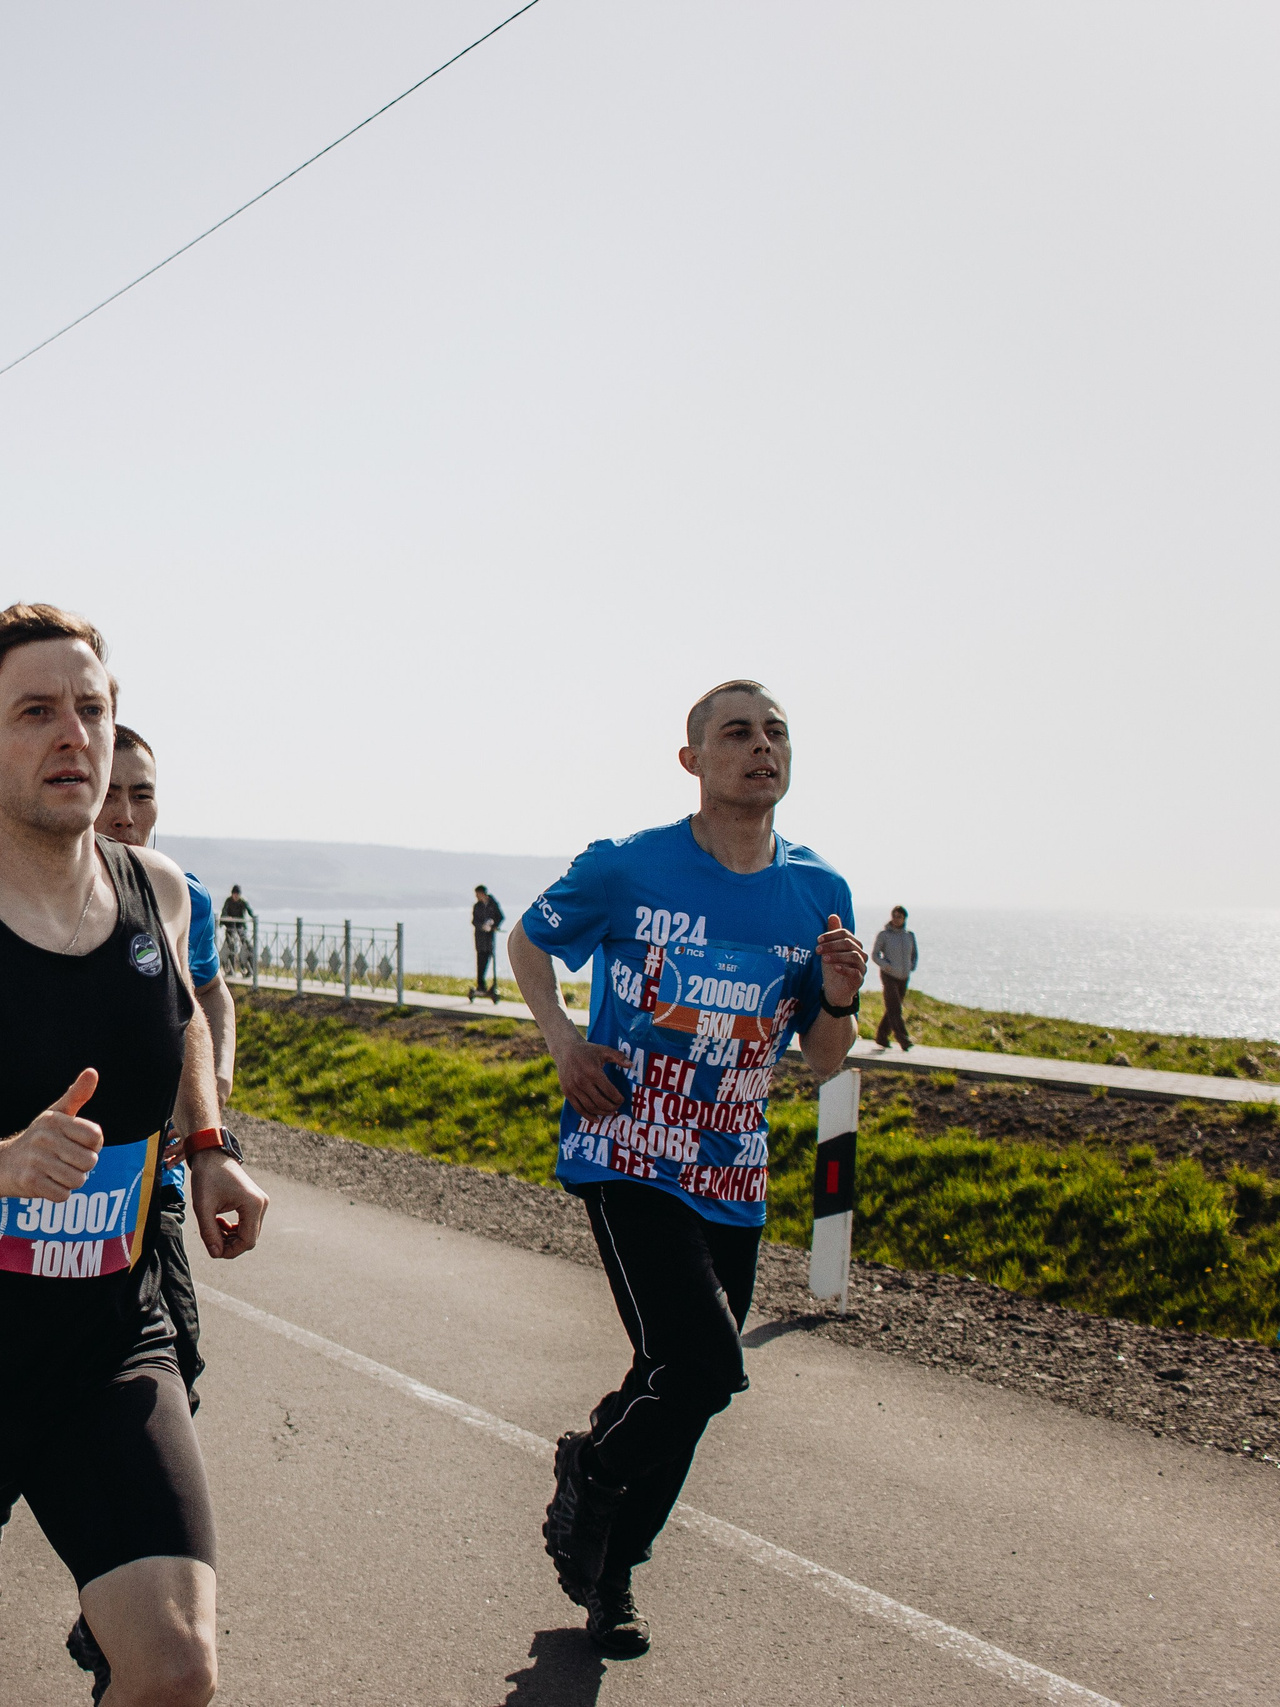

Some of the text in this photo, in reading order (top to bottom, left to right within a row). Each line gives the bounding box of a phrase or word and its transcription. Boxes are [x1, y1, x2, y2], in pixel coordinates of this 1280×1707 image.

[536, 894, 563, 929] ПСБ
[635, 906, 708, 947] 2024
[686, 948, 705, 958] ПСБ
[684, 975, 761, 1013] 20060
[17, 1188, 126, 1235] 30007
